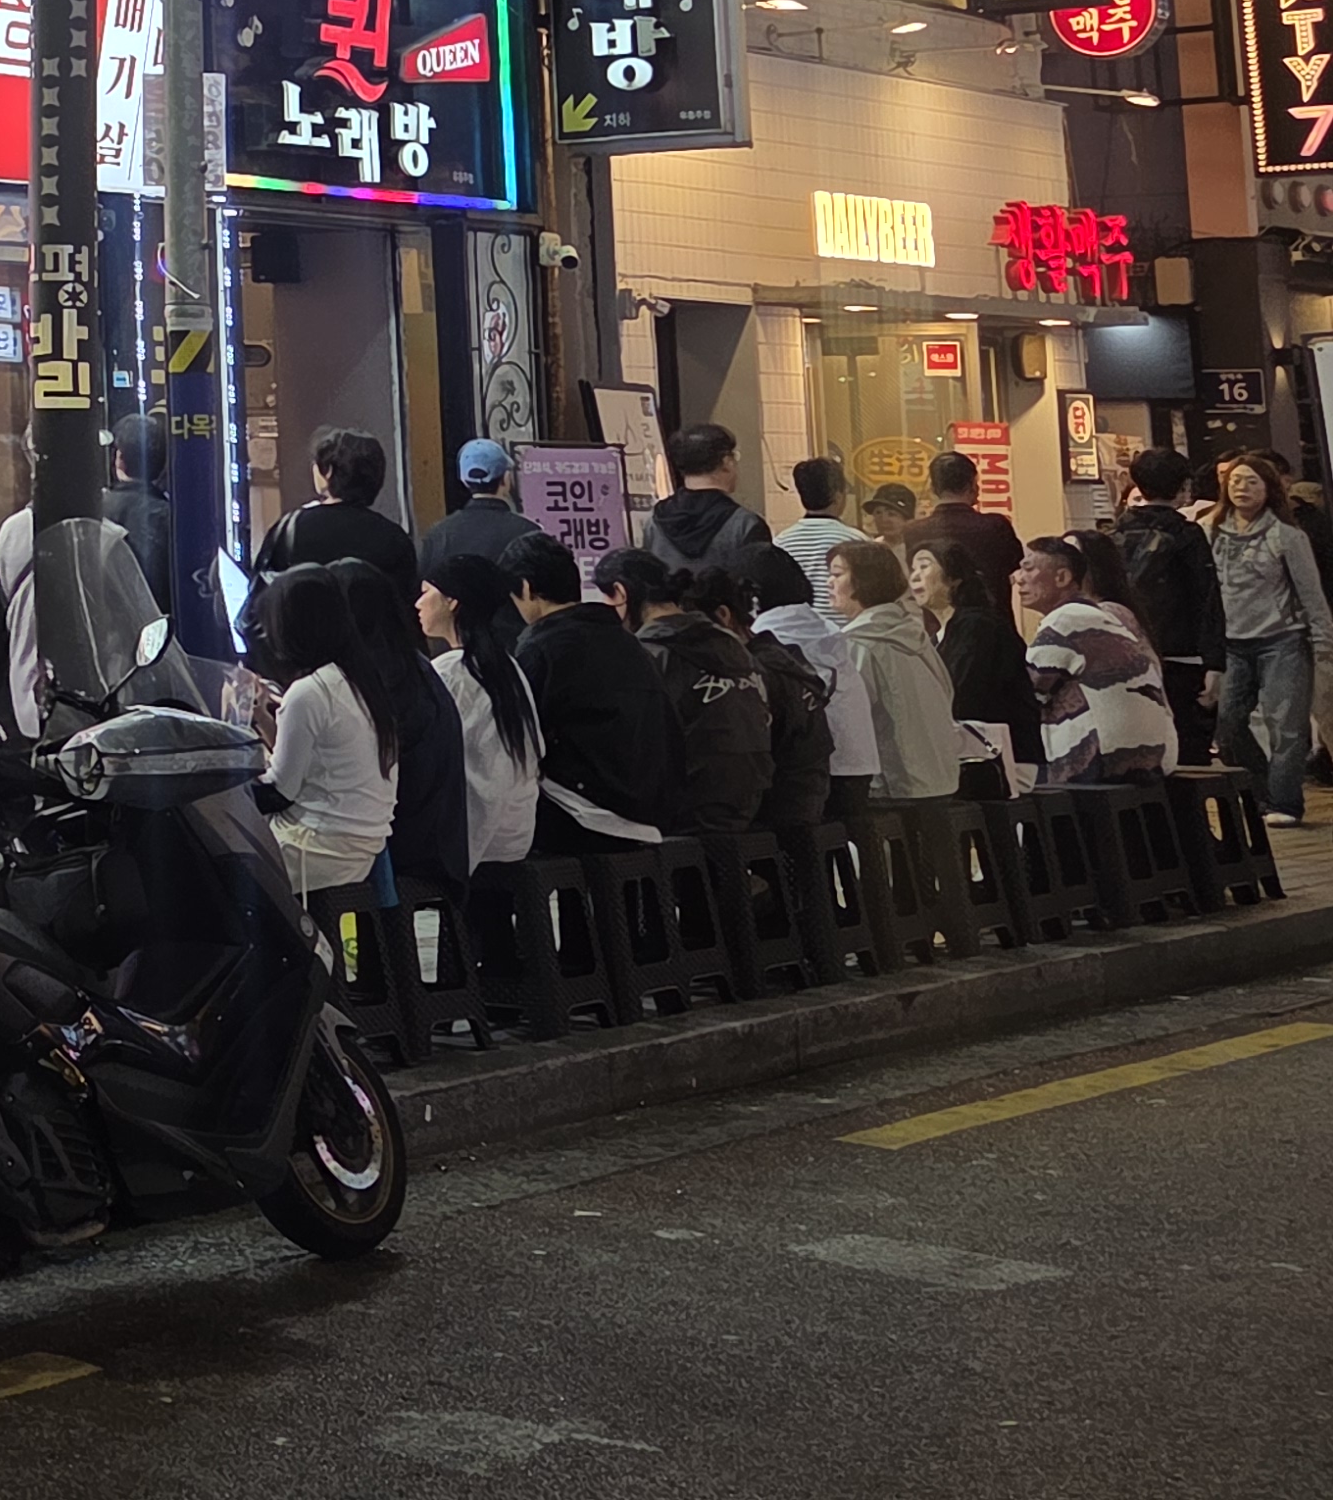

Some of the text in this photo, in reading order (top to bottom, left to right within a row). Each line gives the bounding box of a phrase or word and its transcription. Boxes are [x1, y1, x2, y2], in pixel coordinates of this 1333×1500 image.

[1068, 7, 1138, 46] 맥주
[416, 38, 480, 77] QUEEN
[277, 80, 437, 183] 노래방
[1287, 104, 1333, 157] 7
[813, 190, 936, 268] DAILYBEER
[1218, 382, 1249, 402] 16
[171, 413, 217, 440] 다목
[545, 480, 595, 512] 코인
[536, 518, 611, 551] 래방
